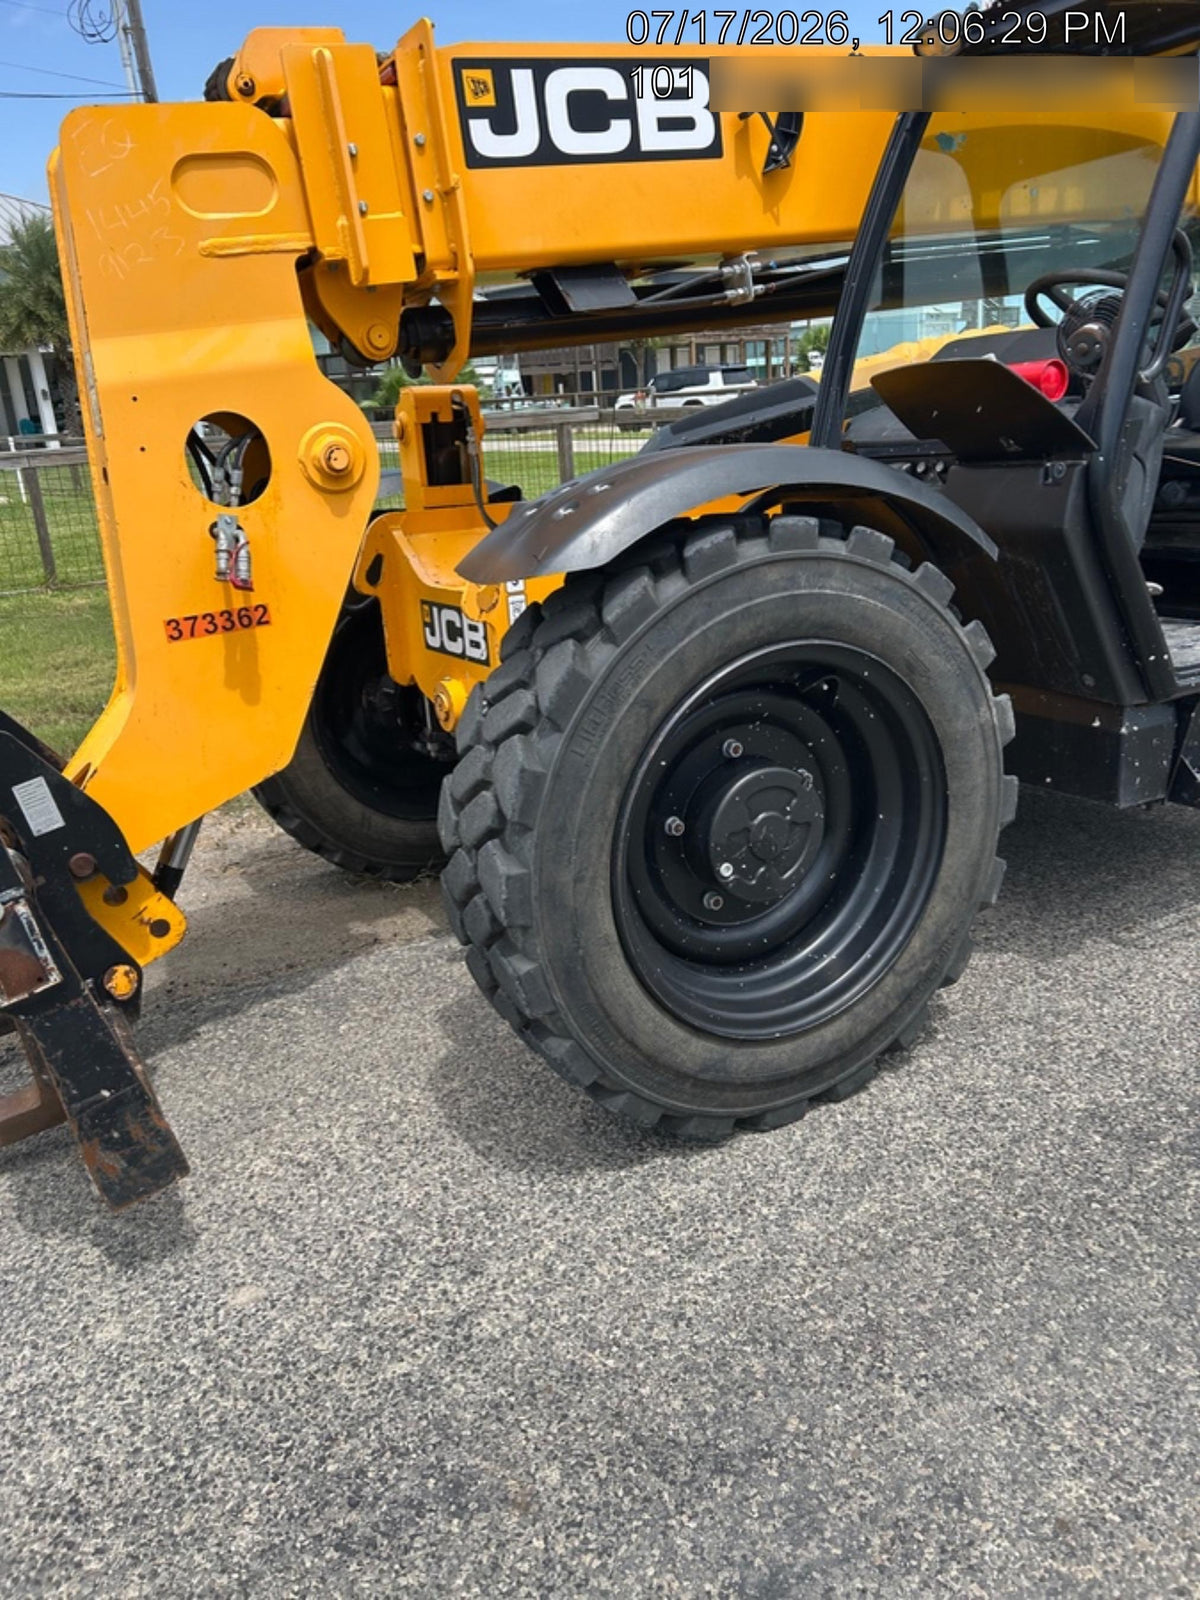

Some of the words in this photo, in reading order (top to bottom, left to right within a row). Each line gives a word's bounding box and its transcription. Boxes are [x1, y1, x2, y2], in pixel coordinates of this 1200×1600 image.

[468, 67, 715, 158] JCB
[166, 604, 270, 641] 373362
[425, 606, 487, 661] JCB
